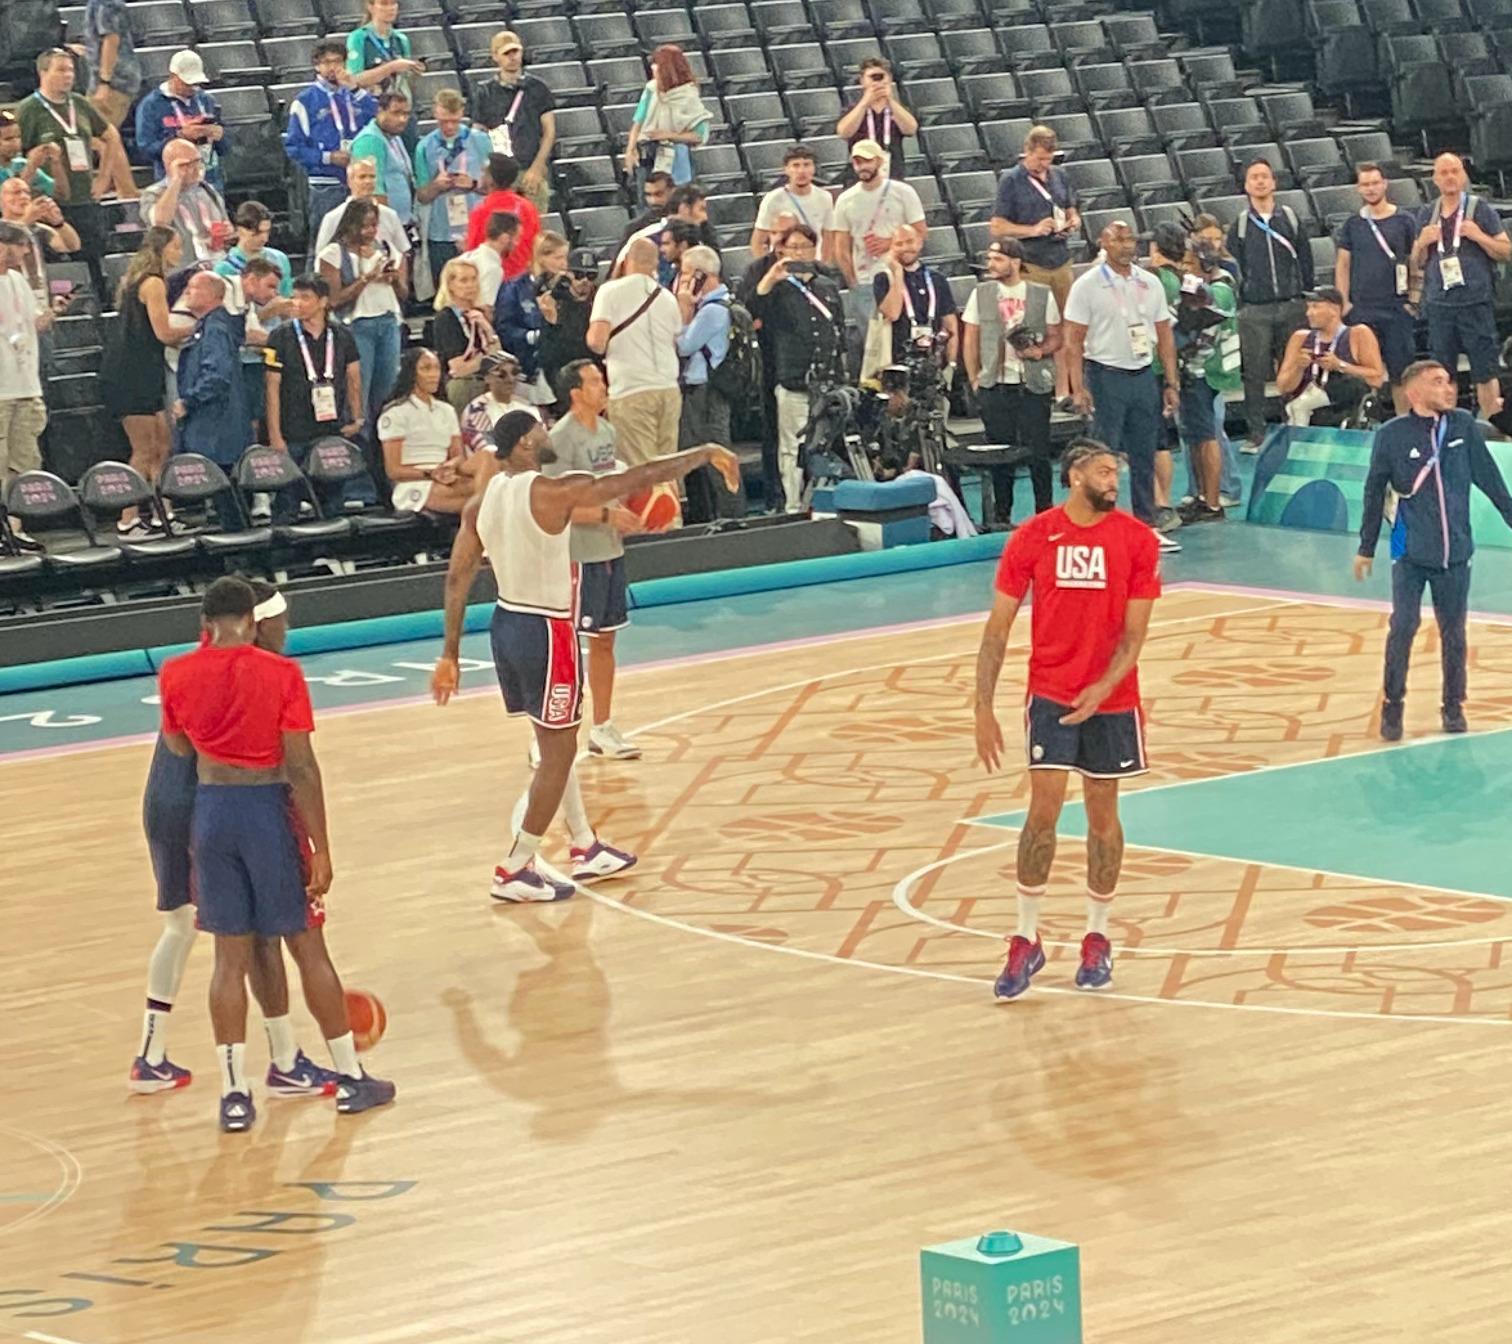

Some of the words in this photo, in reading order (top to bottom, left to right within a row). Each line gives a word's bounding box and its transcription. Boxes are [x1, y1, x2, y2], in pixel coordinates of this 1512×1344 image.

[1056, 546, 1106, 580] USA
[932, 1277, 979, 1304] PARIS
[1006, 1275, 1064, 1305] PARIS
[933, 1300, 980, 1327] 2024
[1008, 1299, 1065, 1326] 2024
